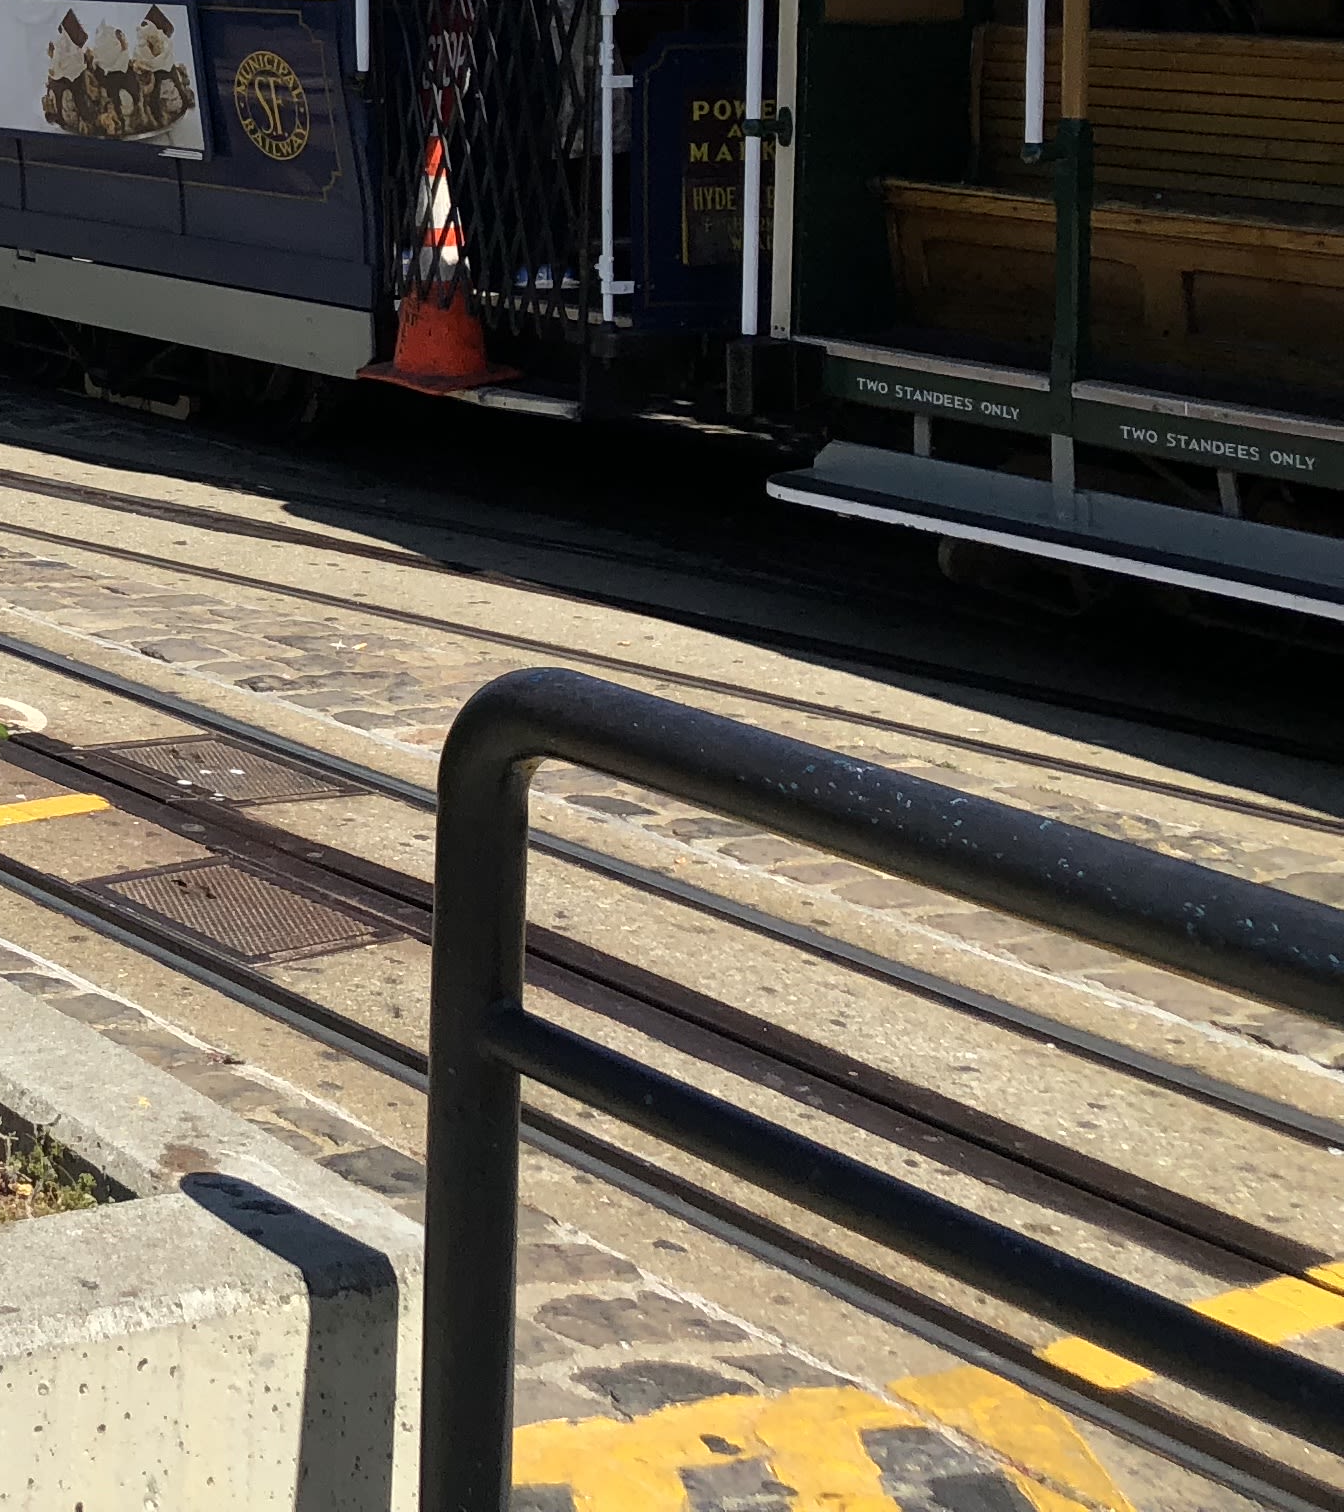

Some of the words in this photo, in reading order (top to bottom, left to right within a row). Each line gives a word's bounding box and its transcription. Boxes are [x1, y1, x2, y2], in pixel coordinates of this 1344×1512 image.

[235, 54, 305, 102] MUNICIPAL
[242, 117, 308, 156] RAILWAY
[693, 185, 737, 211] HYDE
[856, 377, 888, 395] TWO
[895, 384, 973, 411] STANDEES
[980, 401, 1020, 420] ONLY
[1119, 425, 1158, 444] TWO
[1166, 432, 1260, 461] STANDEES
[1269, 450, 1316, 471] ONLY
